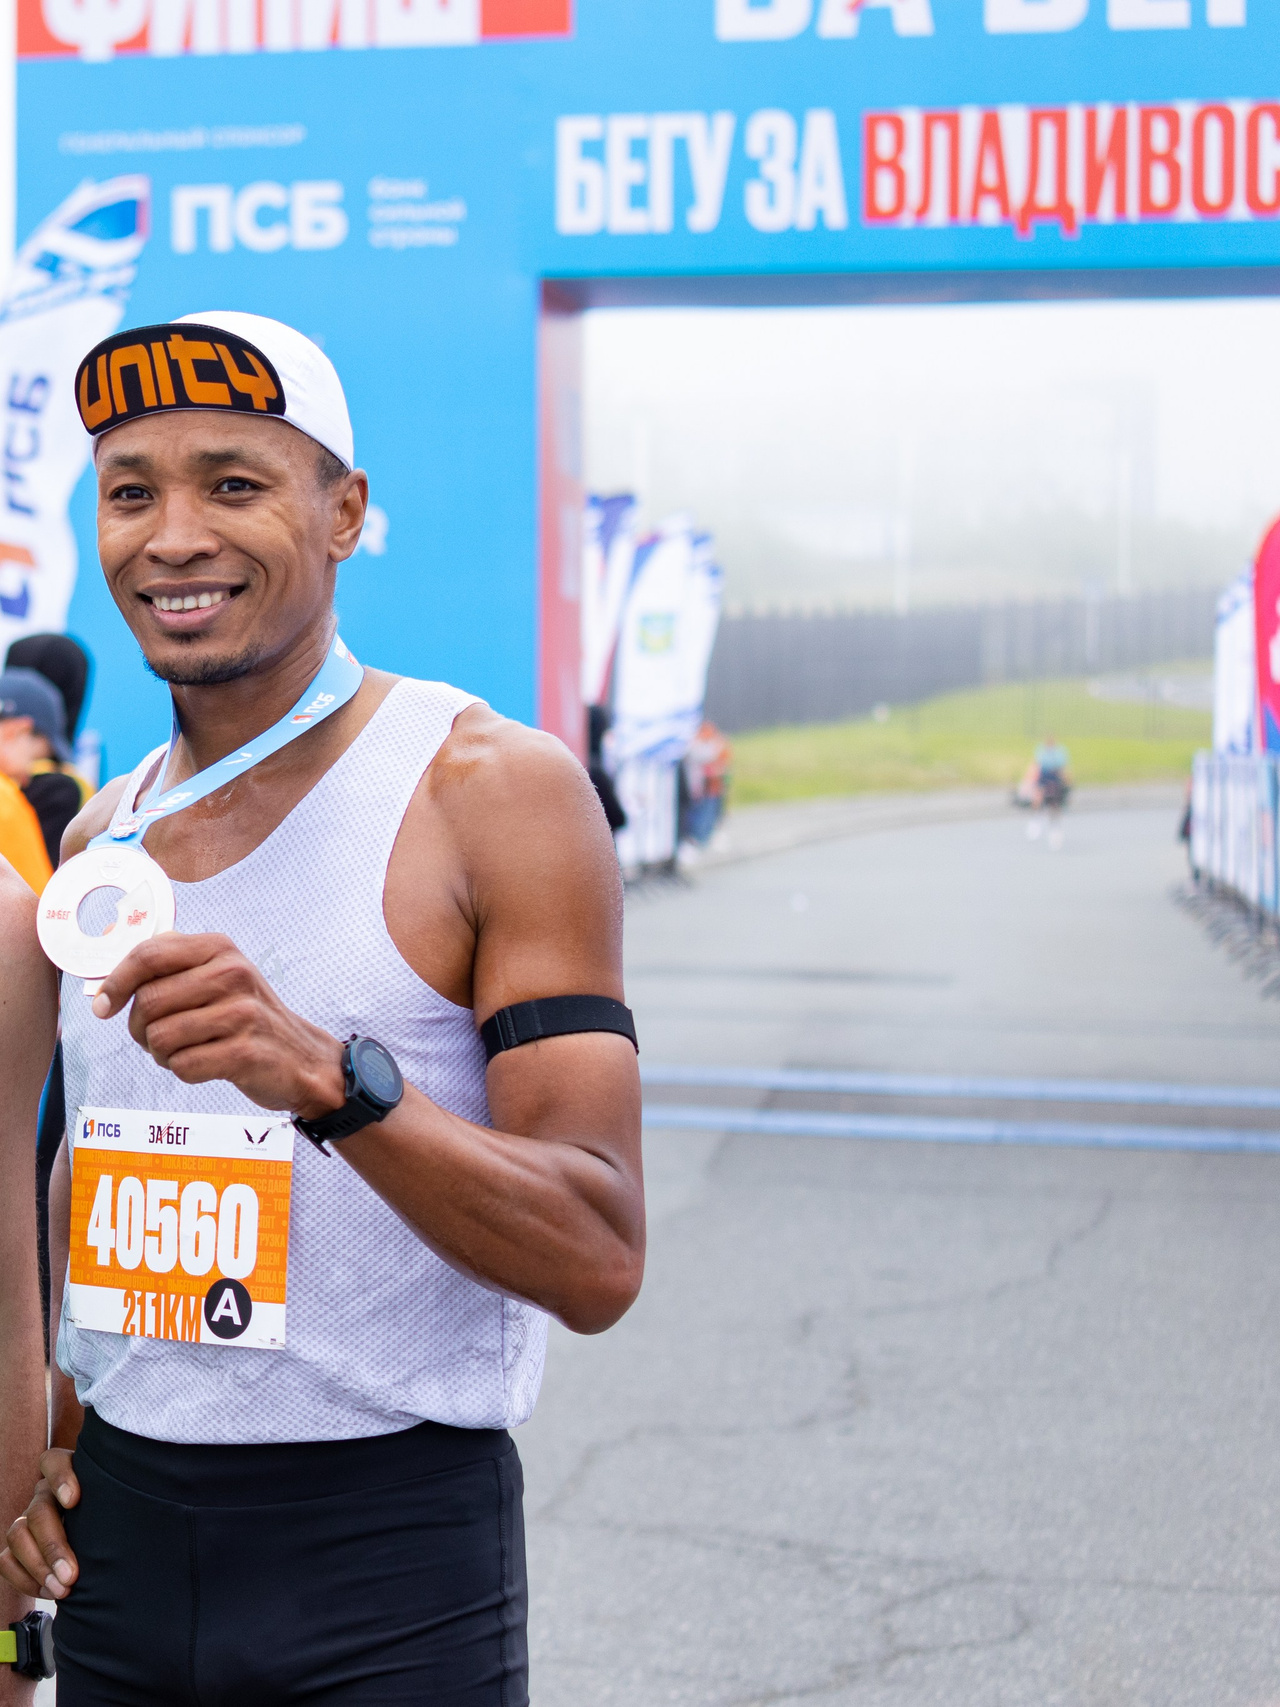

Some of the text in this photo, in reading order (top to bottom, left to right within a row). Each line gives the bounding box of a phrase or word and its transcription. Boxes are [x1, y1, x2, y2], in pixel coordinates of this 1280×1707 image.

[556, 111, 736, 236] БЕГУ
[744, 106, 849, 234] ЗА
[171, 181, 349, 254] ПСБ
[97, 1122, 121, 1138] ПСБ
[87, 1174, 259, 1280] 40560
